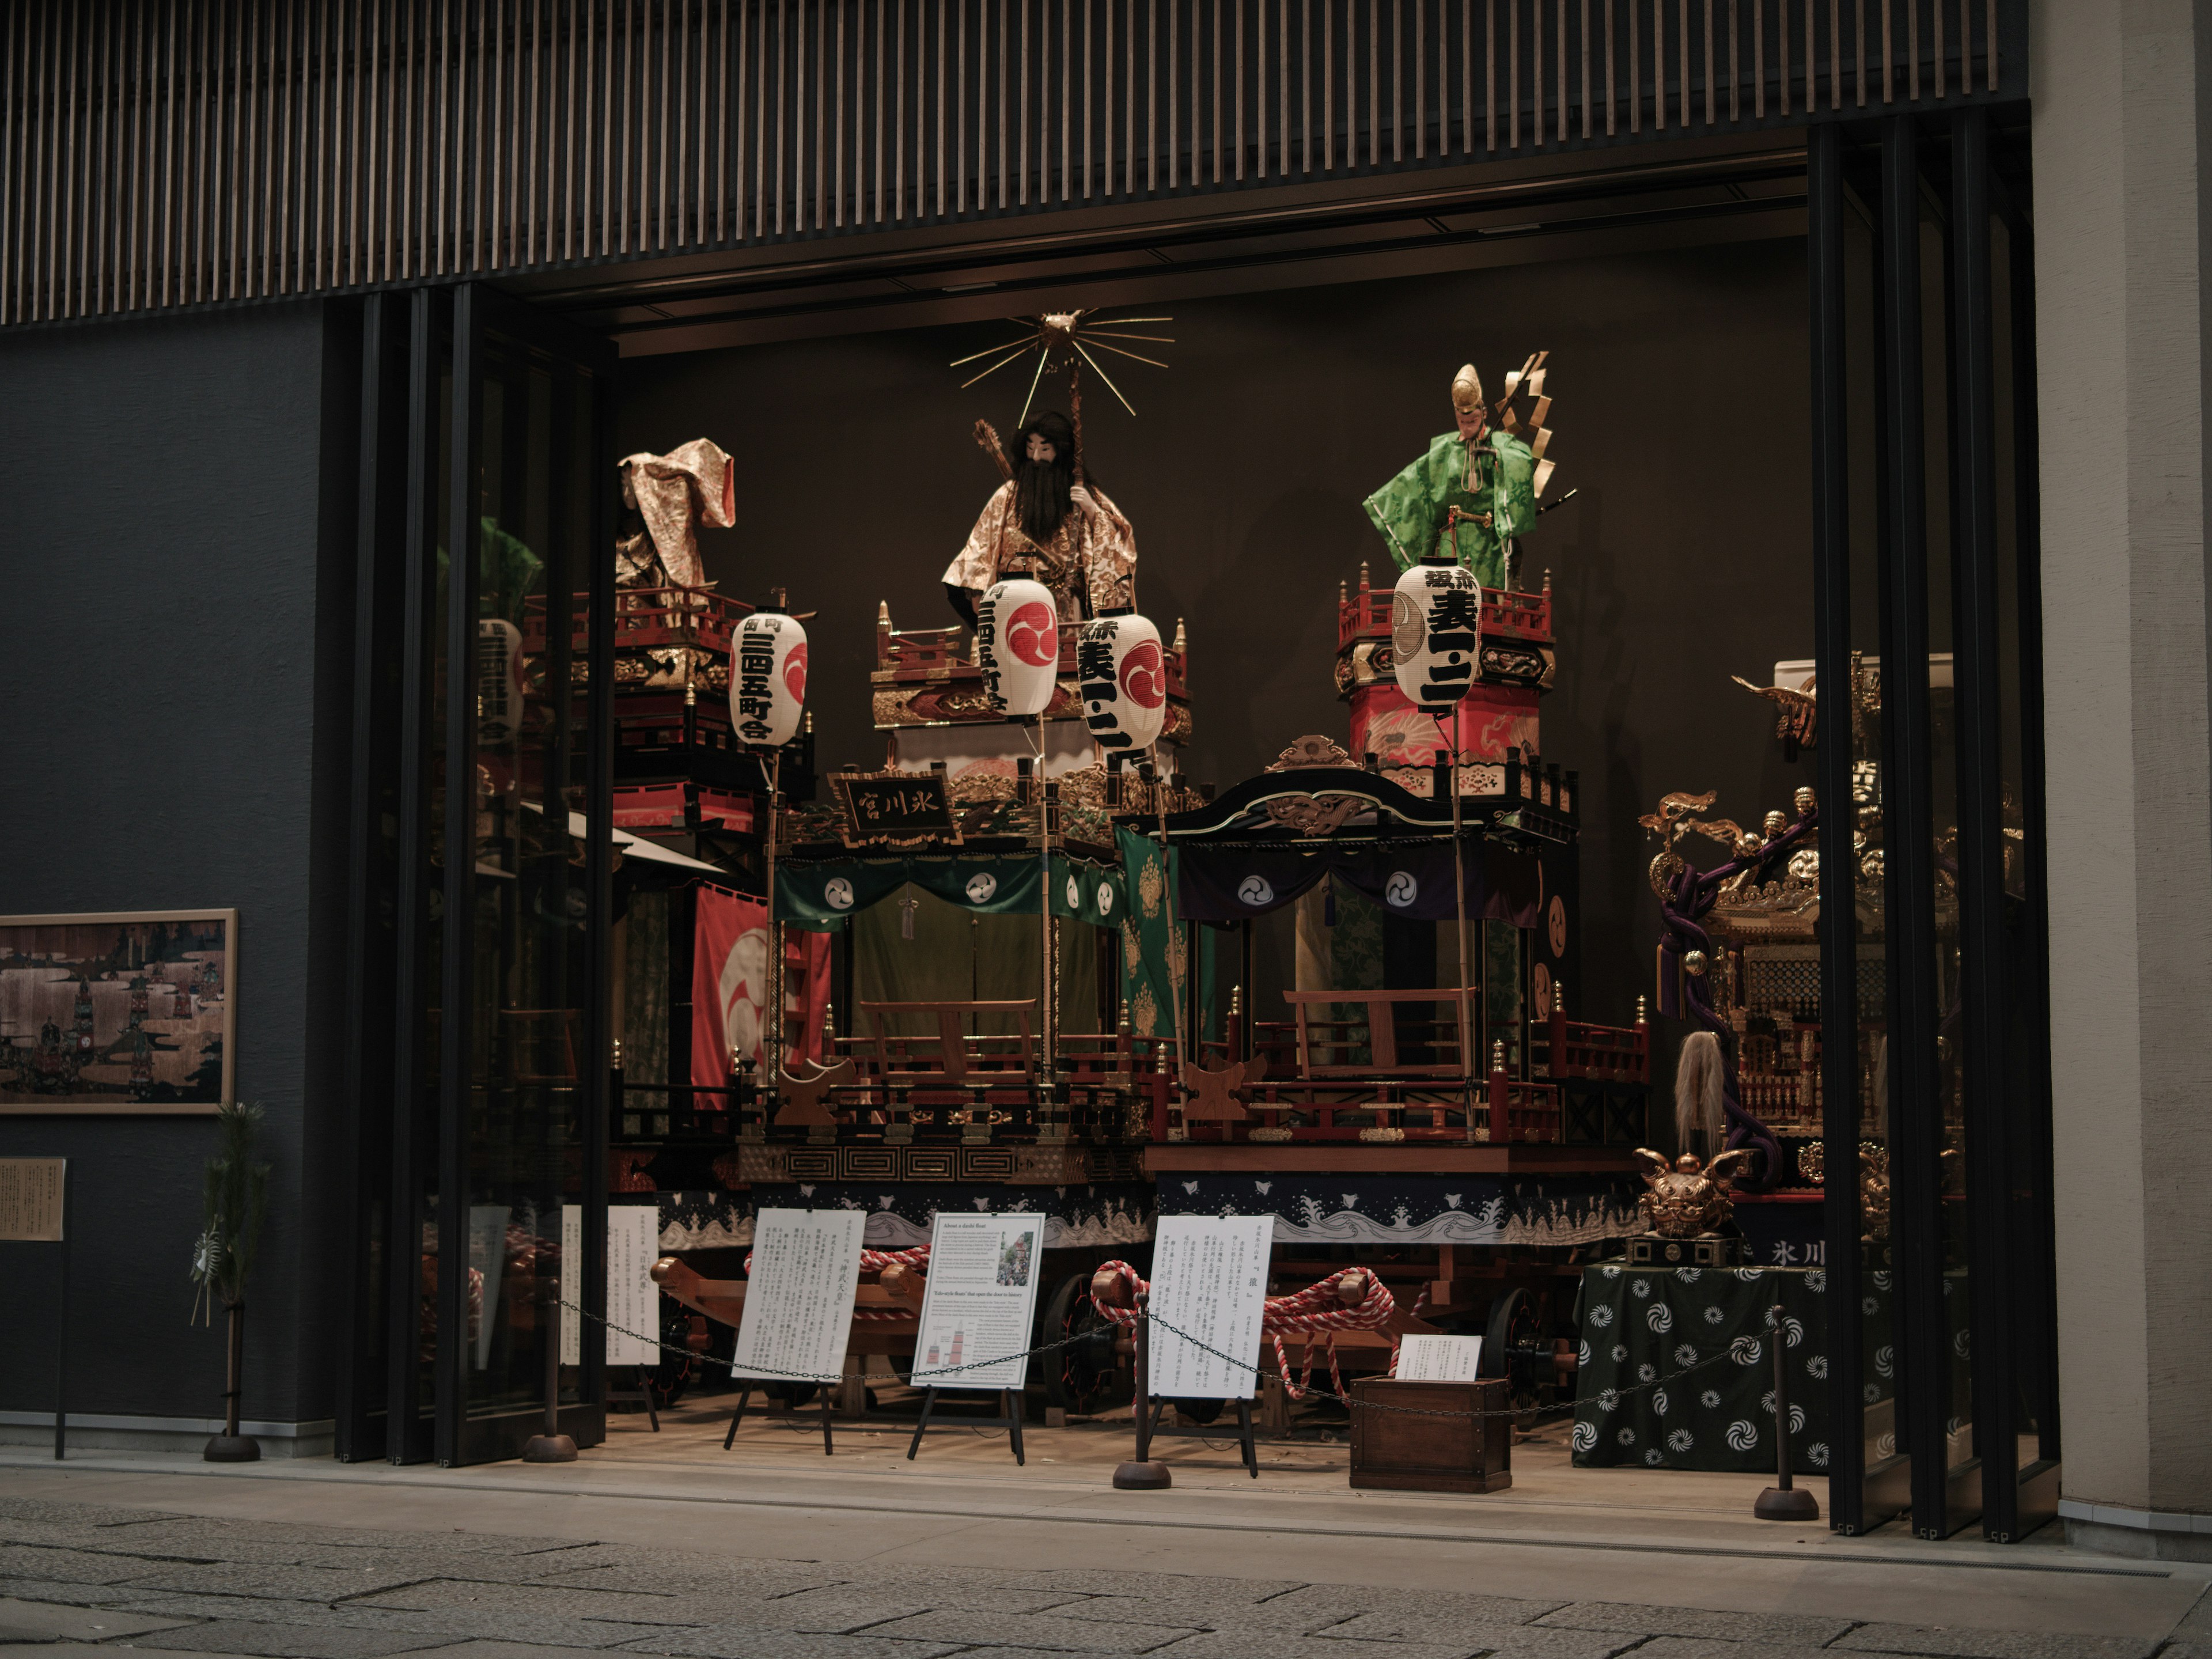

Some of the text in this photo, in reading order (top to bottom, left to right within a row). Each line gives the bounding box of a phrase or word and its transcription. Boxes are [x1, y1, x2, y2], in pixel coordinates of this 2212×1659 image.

[739, 634, 775, 739] 三四五町会
[834, 1259, 850, 1306] 『神武天皇』
